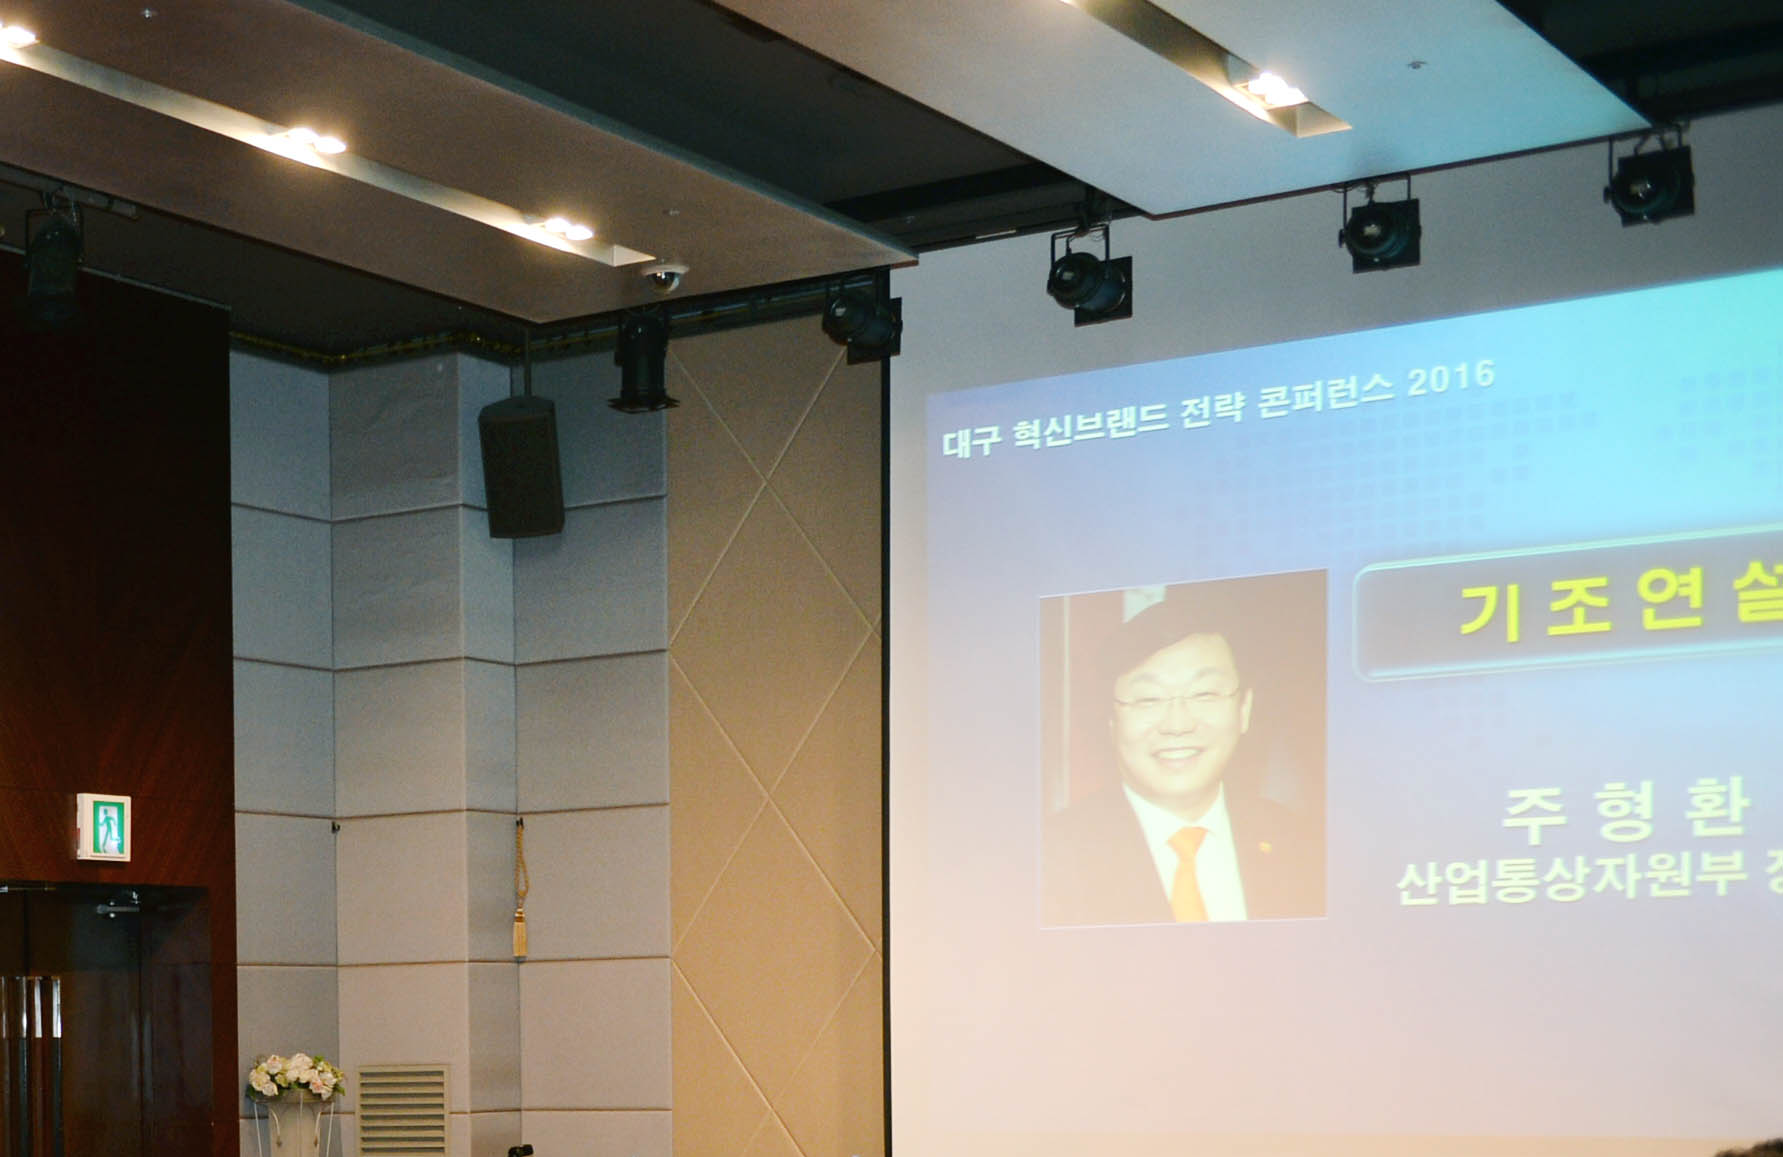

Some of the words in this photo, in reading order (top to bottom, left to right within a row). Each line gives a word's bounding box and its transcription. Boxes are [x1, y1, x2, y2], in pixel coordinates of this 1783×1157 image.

[942, 426, 1003, 458] 대구
[1013, 403, 1171, 450] 혁신브랜드
[1181, 393, 1247, 428] 전략
[1257, 374, 1394, 418] 콘퍼런스
[1408, 359, 1496, 397] 2016
[1397, 850, 1748, 906] 산업통상자원부
